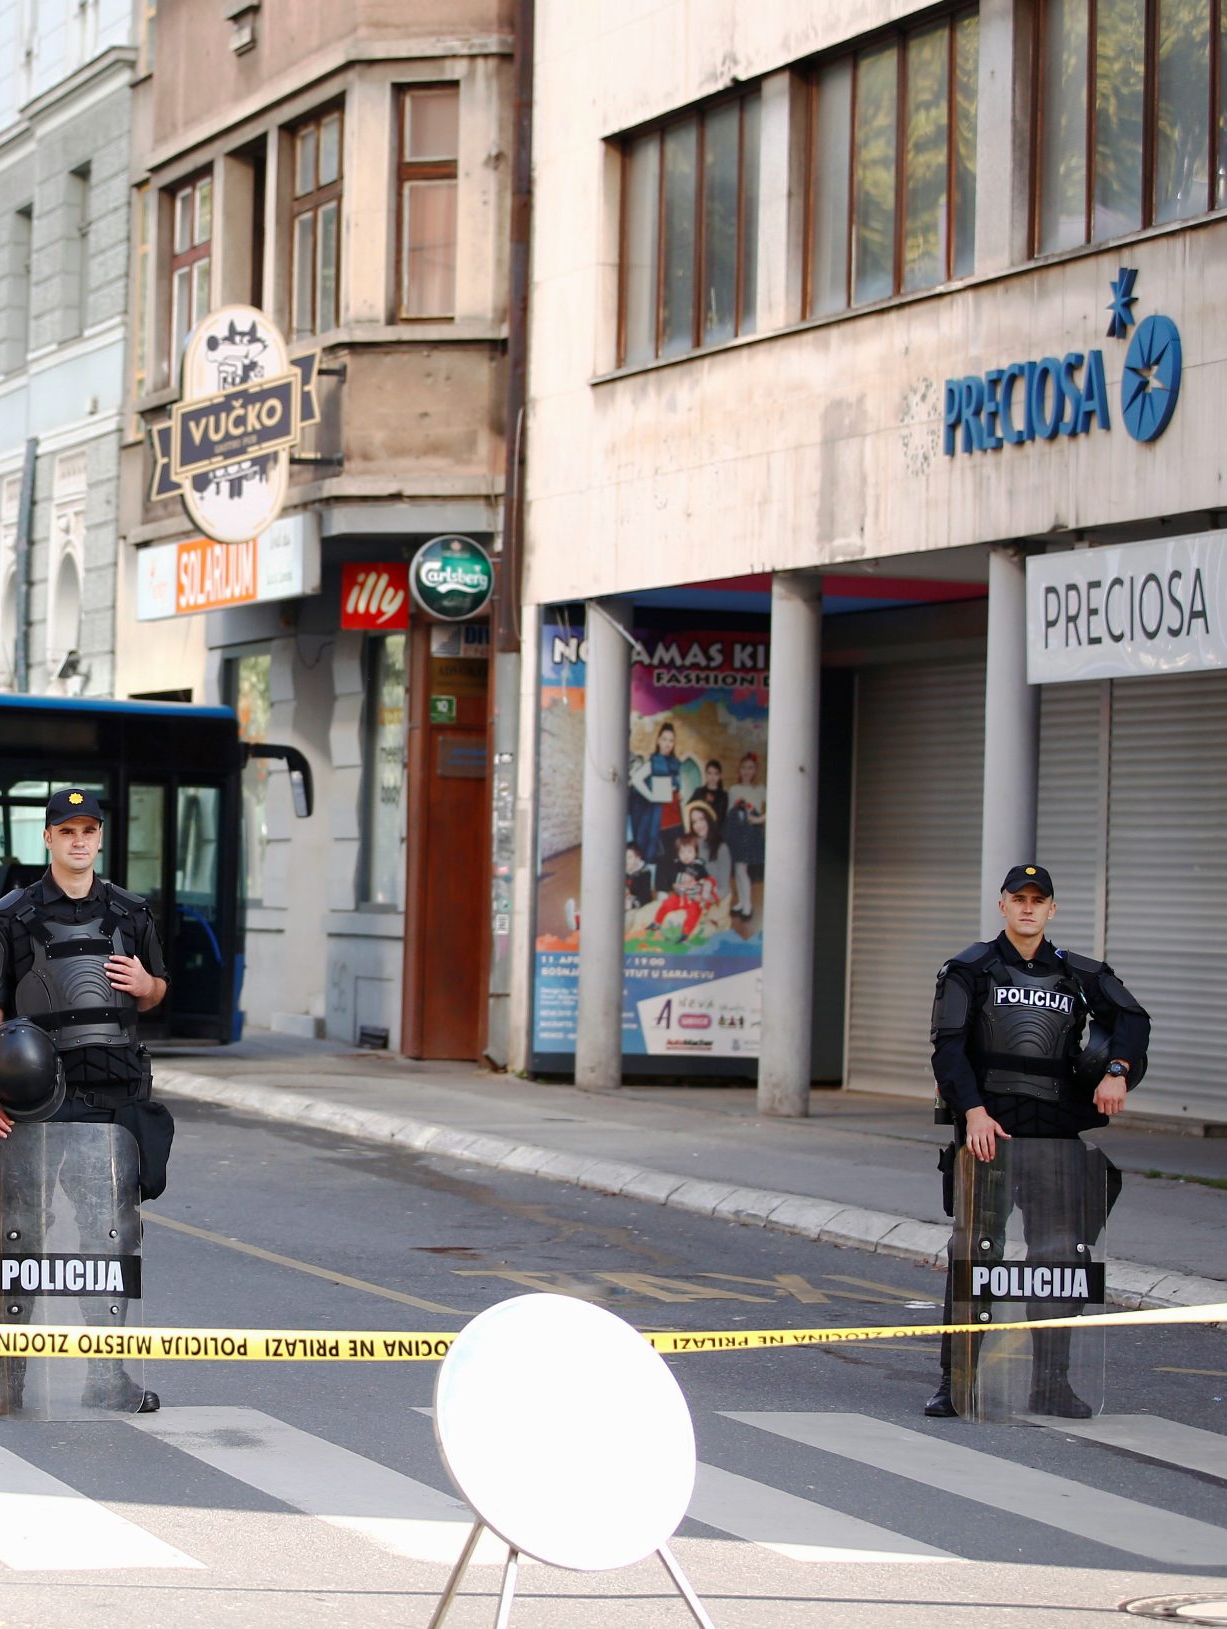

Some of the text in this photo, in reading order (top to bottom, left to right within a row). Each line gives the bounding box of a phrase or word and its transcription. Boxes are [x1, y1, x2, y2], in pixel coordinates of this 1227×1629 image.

[944, 349, 1110, 457] PRECIOSA
[188, 397, 283, 446] VUČKO
[179, 541, 254, 607] SOLARIJUM
[420, 561, 489, 593] Carlsberg
[346, 571, 405, 624] illy
[1044, 567, 1210, 650] PRECIOSA
[631, 641, 724, 667] AMAS
[733, 643, 765, 669] KI
[654, 671, 757, 688] FASHION
[997, 988, 1069, 1013] POLICIJA
[1, 1259, 124, 1292] POLICIJA
[972, 1266, 1089, 1298] POLICIJA
[78, 1334, 152, 1355] MJESTO
[161, 1336, 247, 1356] POLICIJA
[265, 1338, 339, 1357] PRILAZI
[349, 1339, 374, 1357] NE
[383, 1339, 453, 1357] OCINA
[673, 1336, 748, 1350] PRILAZI
[758, 1335, 784, 1345] NE
